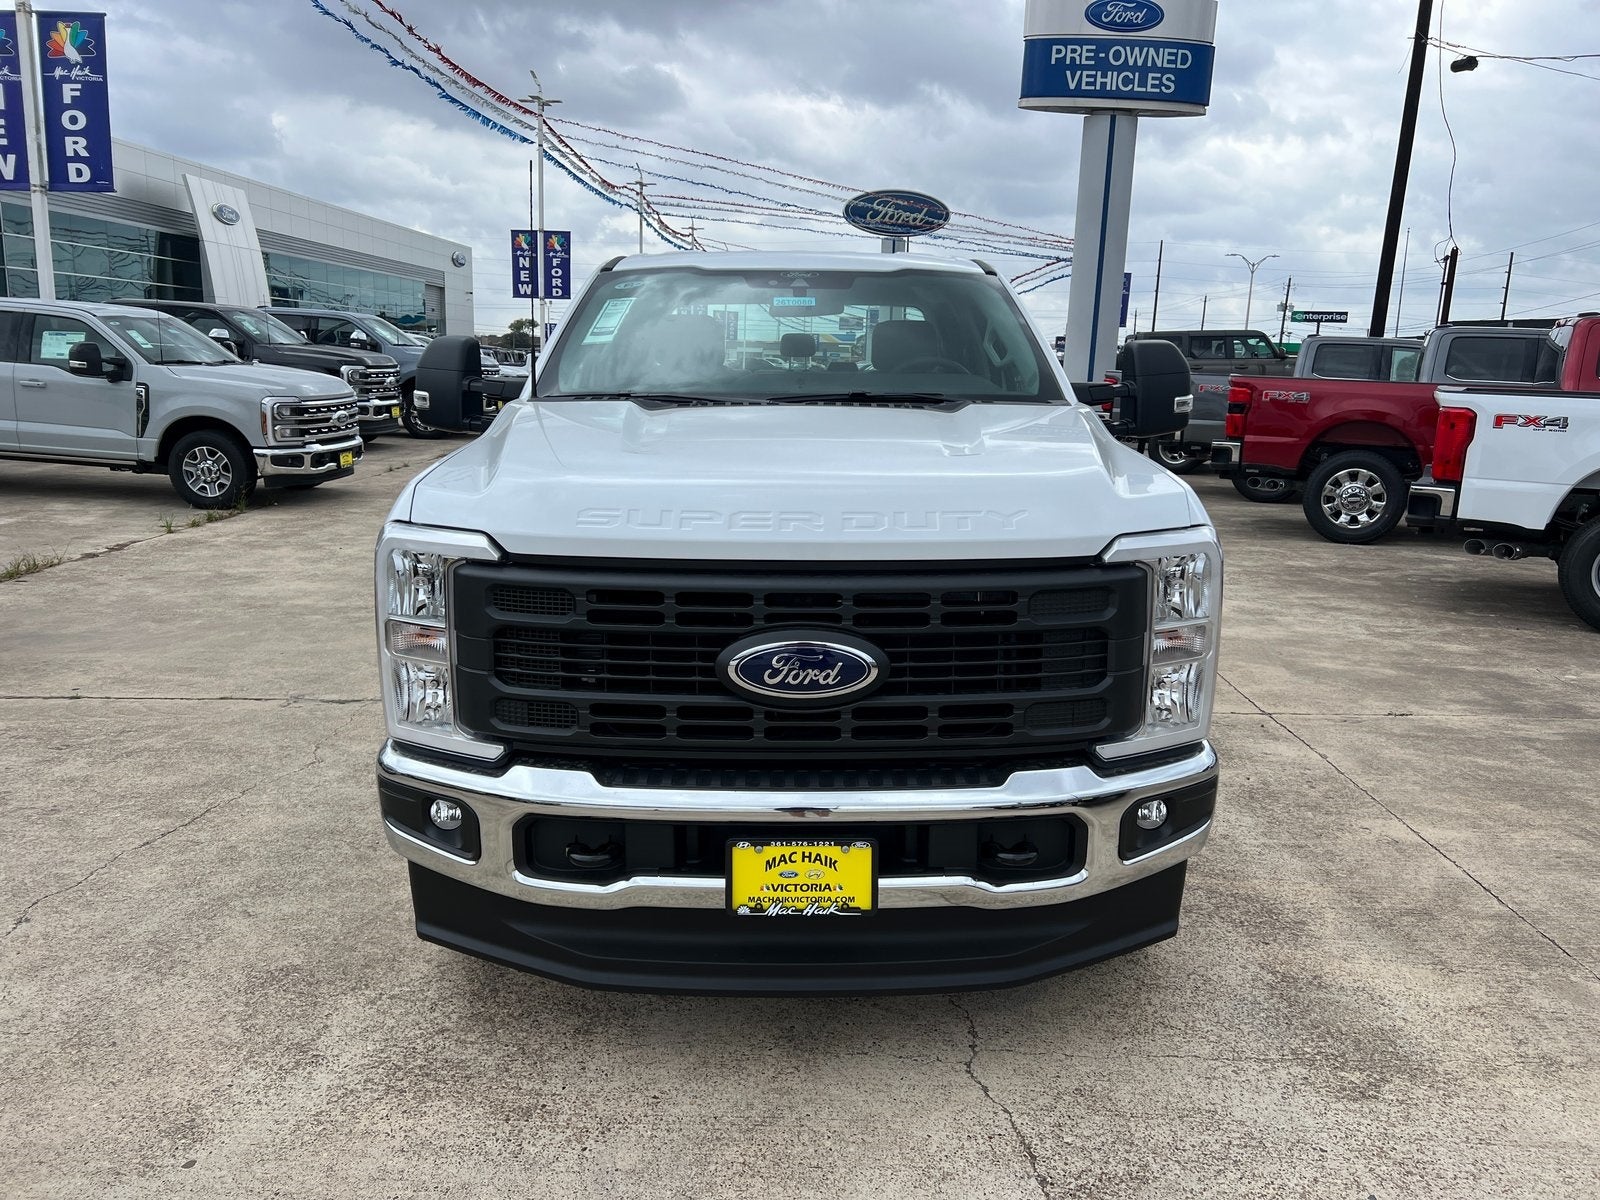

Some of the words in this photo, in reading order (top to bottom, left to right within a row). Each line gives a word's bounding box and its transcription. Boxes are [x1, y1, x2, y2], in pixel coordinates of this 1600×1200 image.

[1101, 1, 1147, 24] Ford
[1050, 44, 1192, 69] PRE-OWNED
[1065, 70, 1176, 94] VEHICLES
[61, 83, 91, 183] FORD
[867, 198, 928, 226] Ford
[518, 256, 532, 295] NEW
[551, 258, 563, 297] FORD
[1293, 312, 1347, 321] enterprise
[1262, 390, 1311, 402] FX4
[1492, 413, 1569, 429] FX4
[576, 506, 825, 532] SUPER
[841, 508, 1029, 533] DUTY
[763, 653, 843, 685] Ford
[765, 851, 798, 872] MAC
[801, 851, 839, 872] HAIK
[771, 883, 832, 893] VICTORIA
[747, 896, 856, 904] MACHAIKVICTORIA.COM
[764, 902, 801, 917] Mac
[802, 902, 840, 917] Haik
